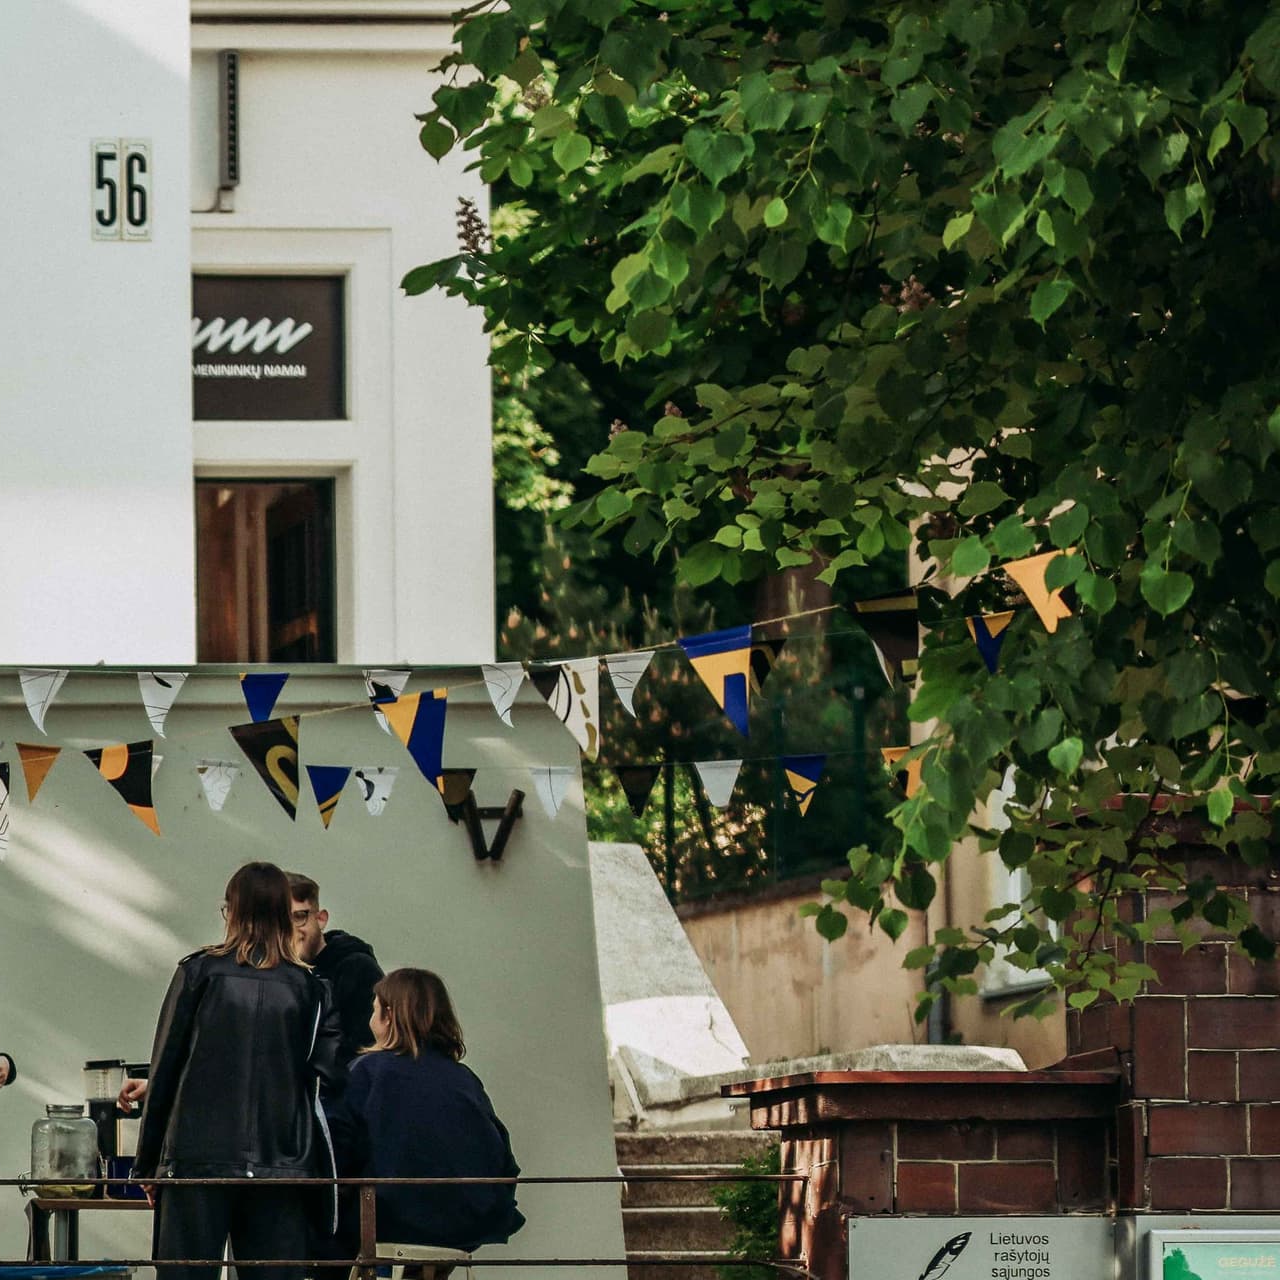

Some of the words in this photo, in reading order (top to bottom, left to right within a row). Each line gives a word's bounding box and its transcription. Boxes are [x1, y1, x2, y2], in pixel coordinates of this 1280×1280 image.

[95, 151, 148, 228] 56
[263, 364, 307, 377] NAMAI
[989, 1232, 1050, 1245] Lietuvos
[994, 1248, 1051, 1265] rašytojų
[991, 1266, 1051, 1280] sąjungos
